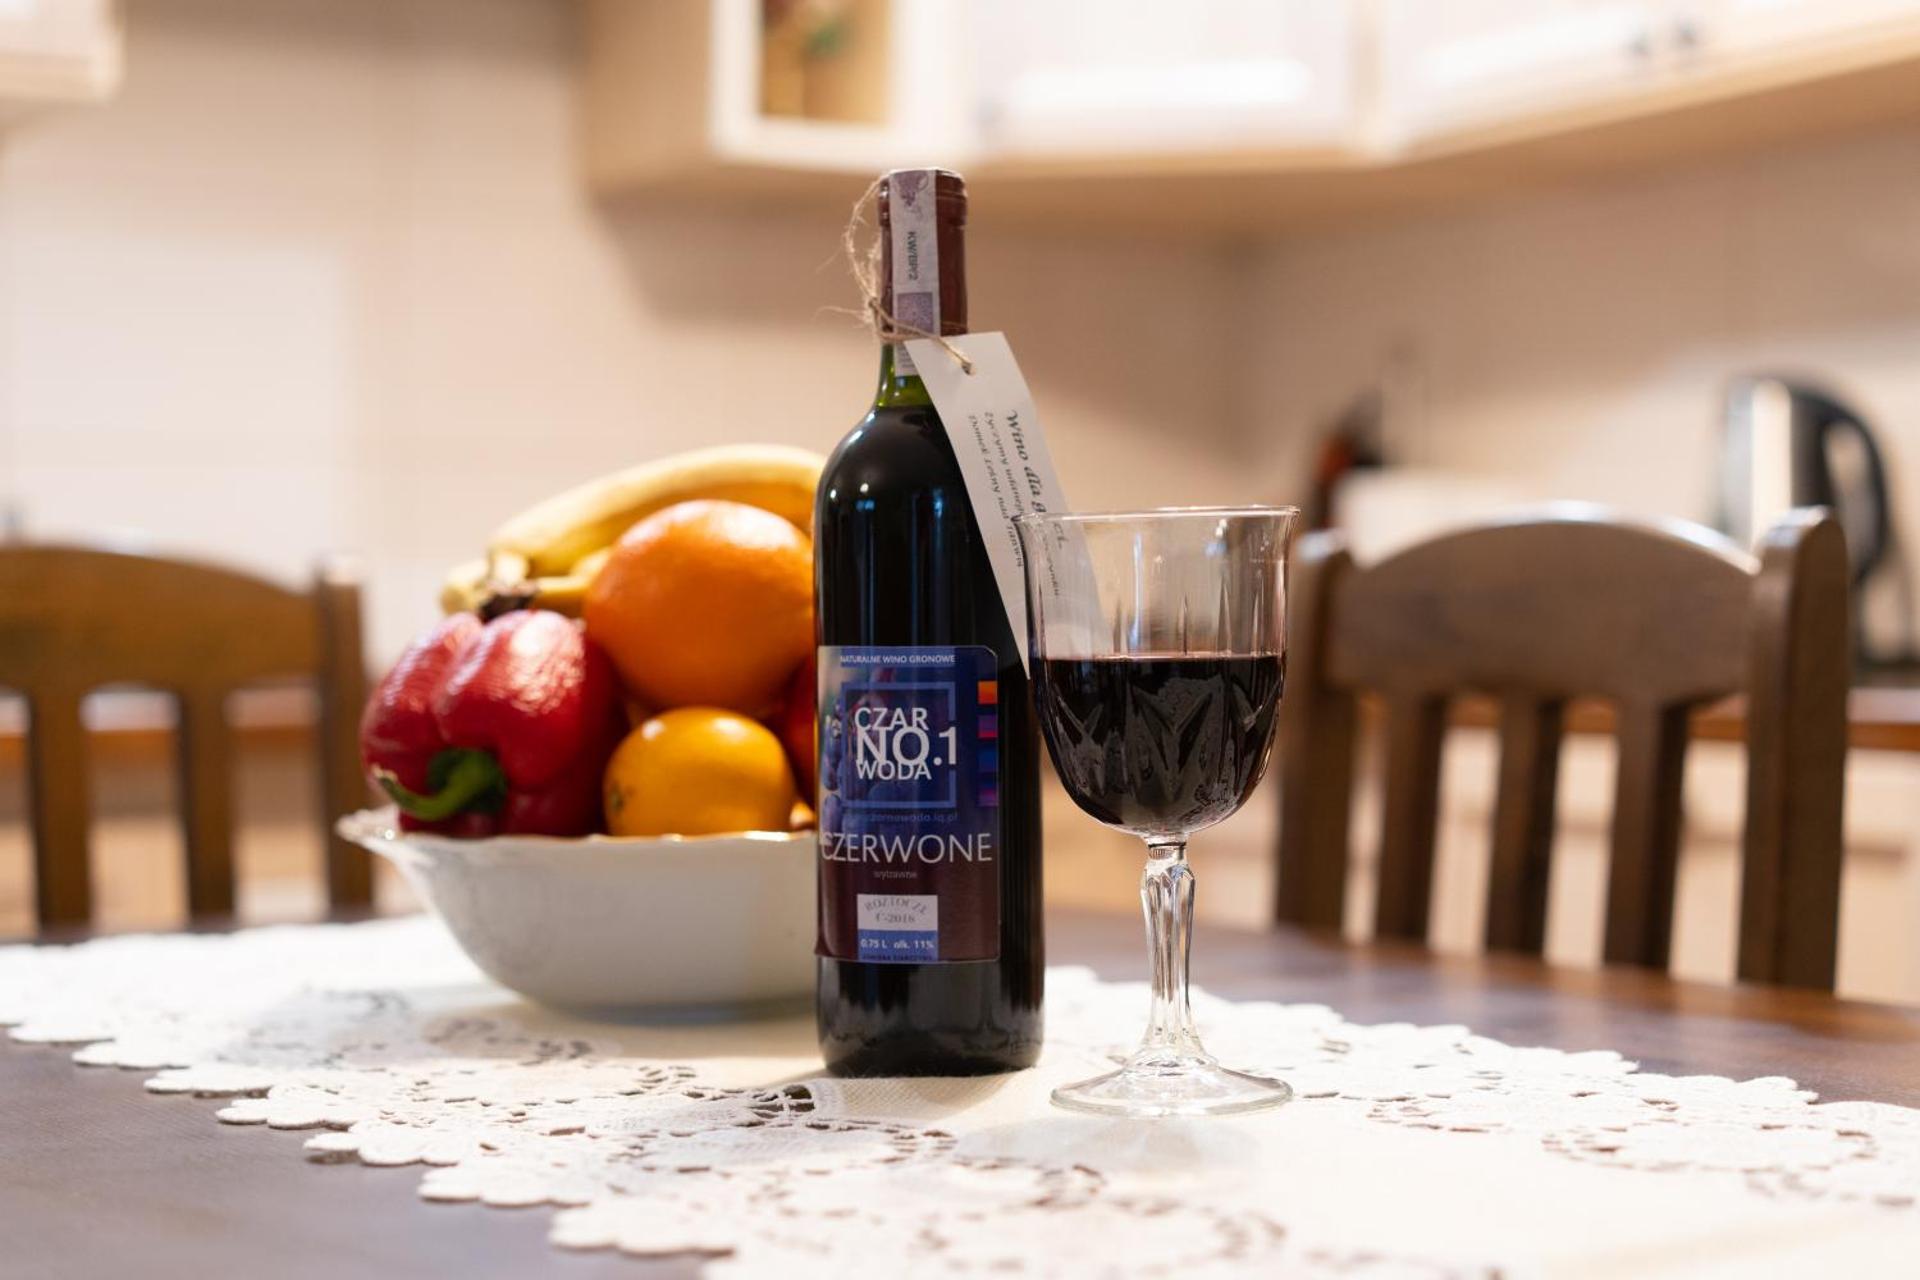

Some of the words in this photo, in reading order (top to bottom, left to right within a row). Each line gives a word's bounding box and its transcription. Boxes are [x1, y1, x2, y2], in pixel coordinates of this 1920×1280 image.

[1006, 410, 1028, 461] Wino
[1024, 466, 1043, 496] dla
[840, 654, 881, 664] NATURALNE
[882, 654, 907, 664] WINO
[909, 654, 956, 664] GRONOWE
[854, 706, 930, 731] CZAR
[856, 726, 957, 766] NO.1
[856, 759, 932, 780] WODA
[820, 832, 993, 864] CZERWONE
[881, 938, 888, 949] L
